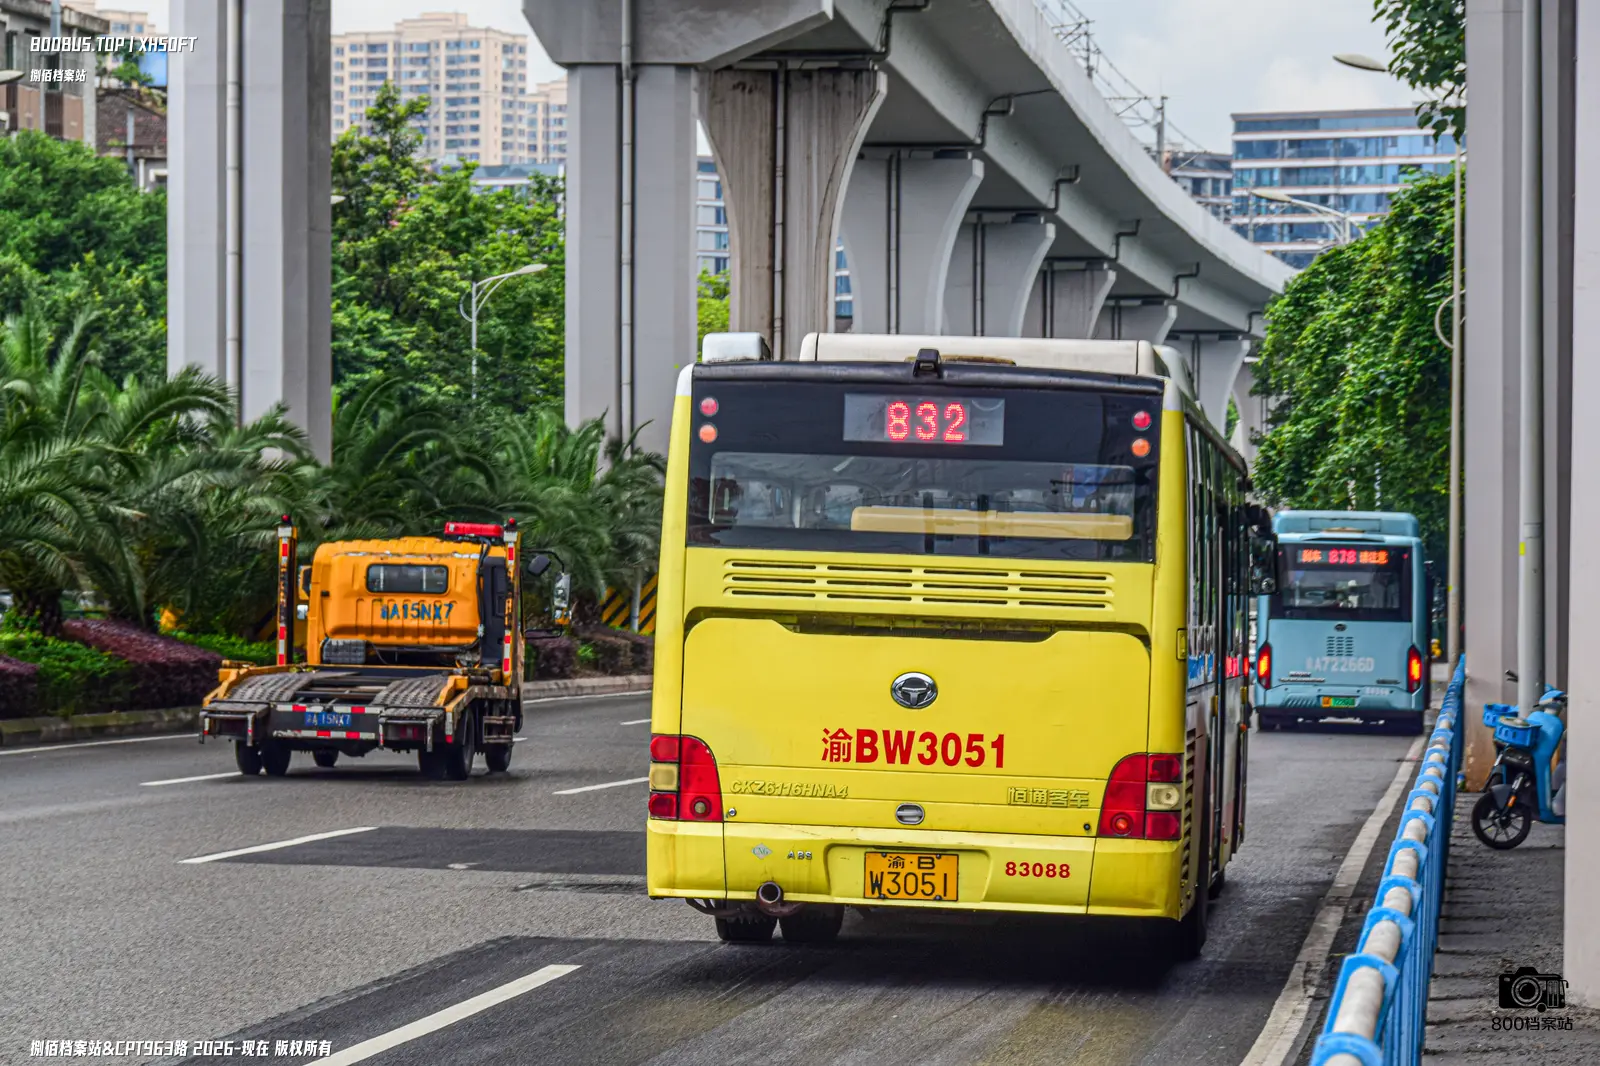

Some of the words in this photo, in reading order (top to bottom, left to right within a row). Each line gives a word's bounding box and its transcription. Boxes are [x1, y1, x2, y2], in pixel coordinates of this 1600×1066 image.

[886, 400, 966, 443] 832
[1305, 656, 1375, 673] A72266D
[821, 727, 1005, 769] 渝BW3051
[730, 780, 849, 799] CKZ6116HNA4
[1007, 787, 1090, 809] 恒通客车
[787, 850, 813, 860] ABS
[1005, 861, 1071, 879] 83088
[869, 870, 948, 898] W3051
